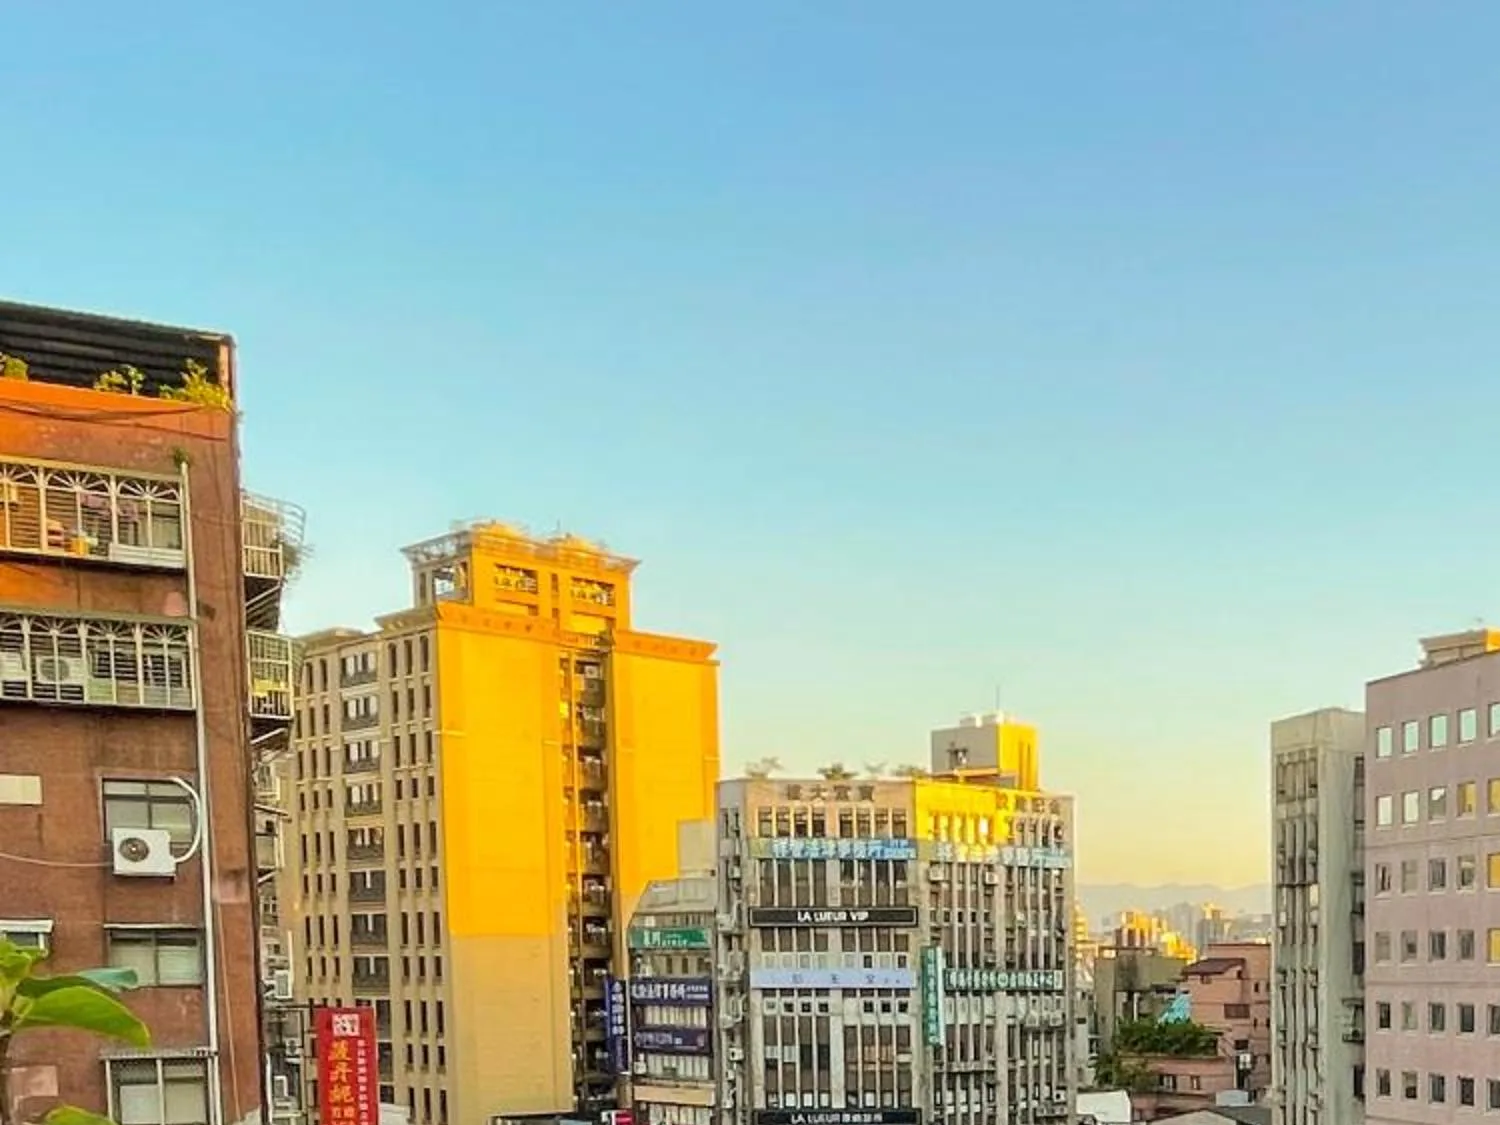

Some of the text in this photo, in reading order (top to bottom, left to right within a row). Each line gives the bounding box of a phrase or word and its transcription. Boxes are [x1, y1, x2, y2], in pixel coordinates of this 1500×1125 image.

[797, 911, 812, 922] LA
[850, 911, 869, 922] VIP
[791, 1113, 806, 1125] LA
